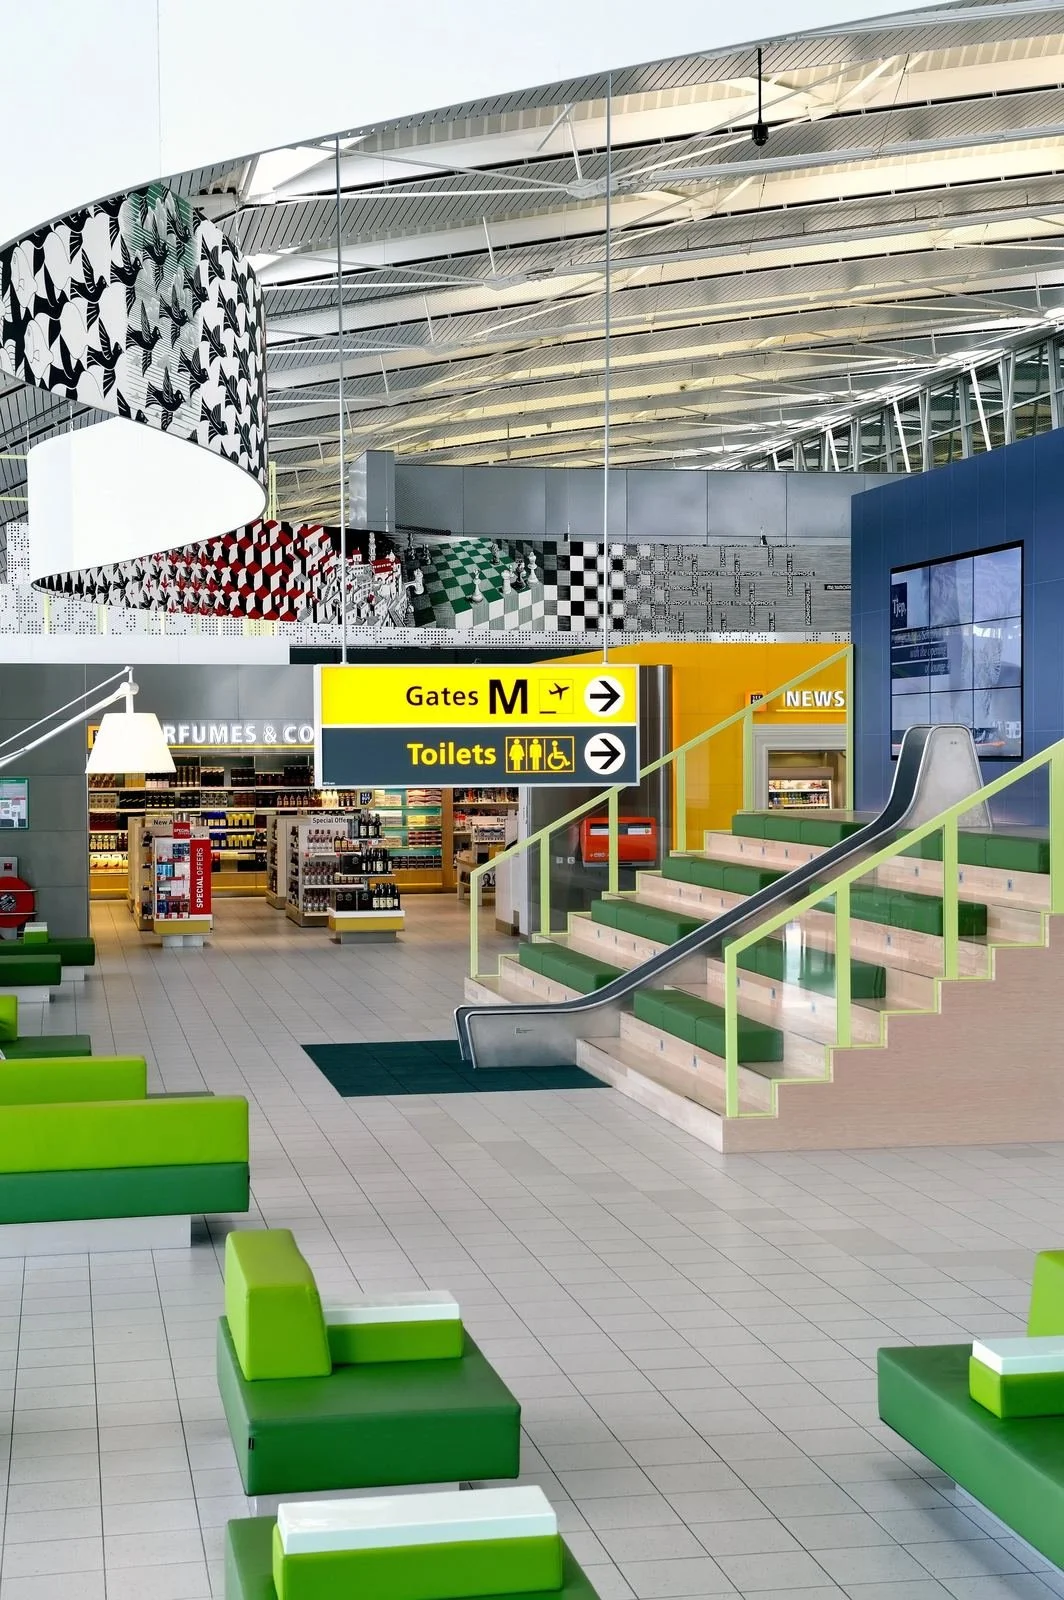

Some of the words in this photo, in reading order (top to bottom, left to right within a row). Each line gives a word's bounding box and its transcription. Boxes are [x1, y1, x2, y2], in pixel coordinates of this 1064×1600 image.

[405, 686, 479, 706] Gates
[489, 679, 528, 714] M
[786, 691, 845, 707] NEWS
[163, 725, 257, 743] RFUMES
[264, 725, 277, 743] &
[284, 725, 314, 743] CO
[406, 742, 497, 766] Toilets
[196, 847, 204, 876] OFFERS
[196, 877, 204, 908] SPECIAL
